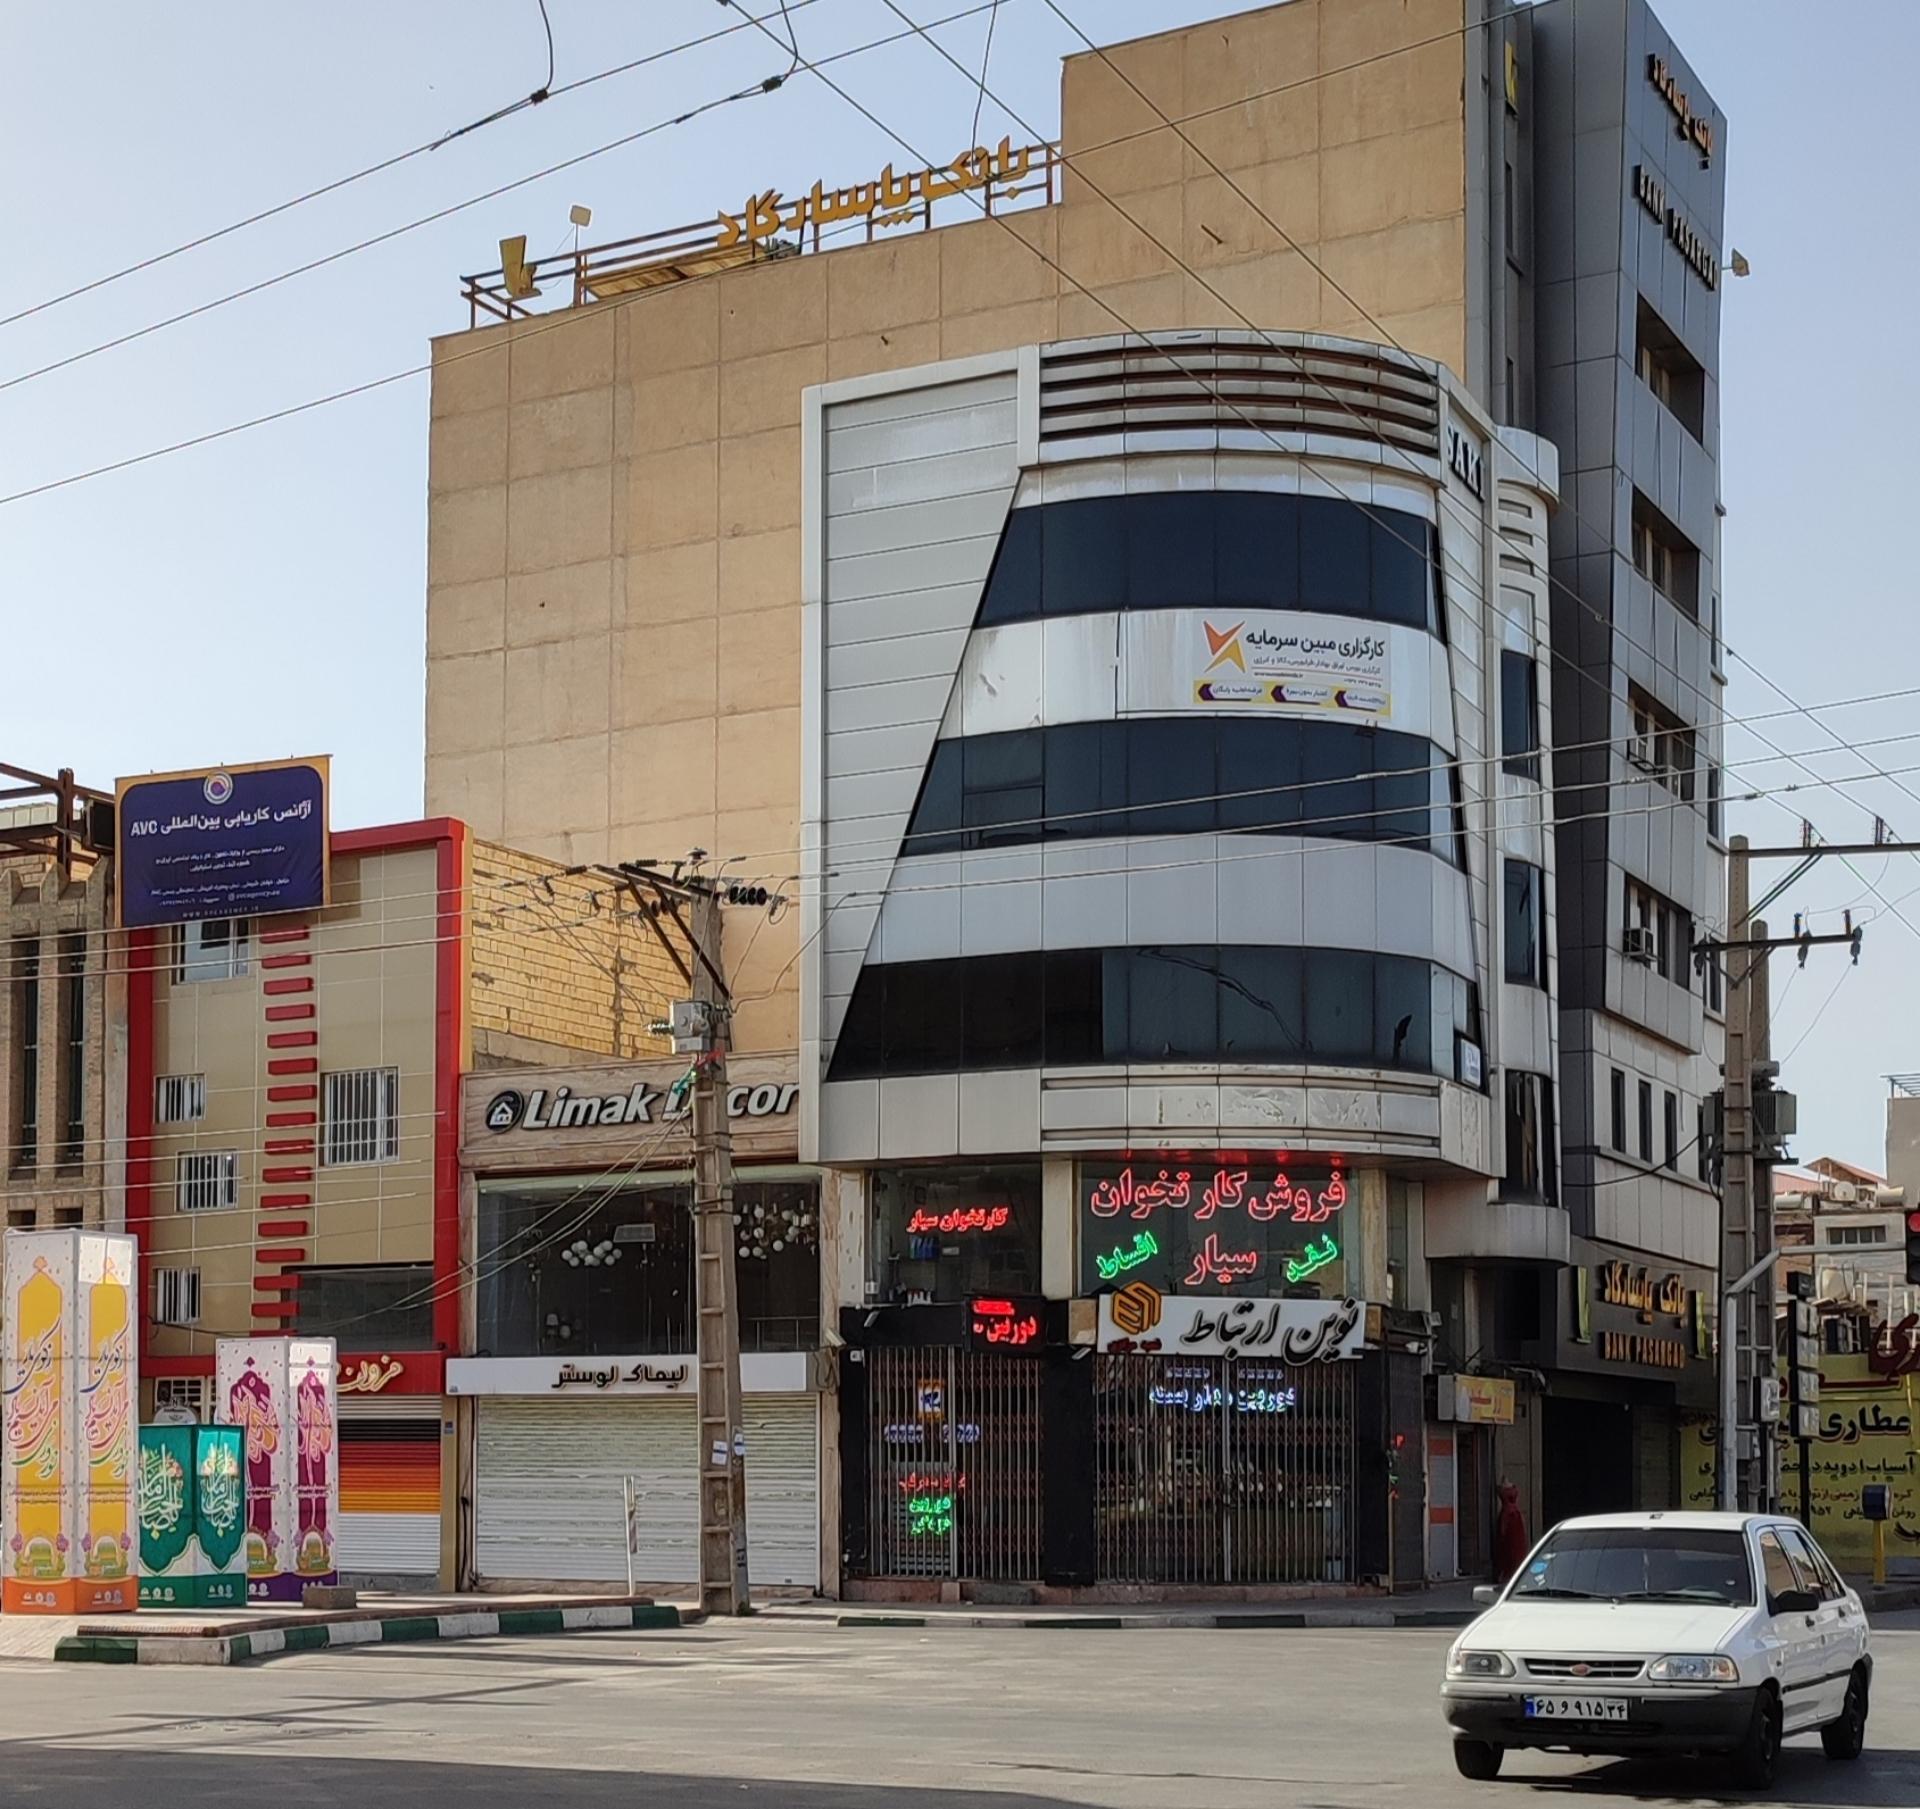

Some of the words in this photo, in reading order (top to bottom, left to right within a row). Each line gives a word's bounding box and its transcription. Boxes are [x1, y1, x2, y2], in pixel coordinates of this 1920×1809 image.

[919, 135, 1030, 200] بانک
[717, 163, 914, 248] پاسارگاد
[1633, 164, 1665, 225] BANK
[1246, 629, 1298, 651] سرمایه
[1300, 638, 1337, 654] مبین
[1338, 636, 1385, 660] کارگزاری
[130, 820, 158, 838] AVC
[224, 806, 270, 828] کاریابی
[274, 800, 312, 822] آژانس
[522, 1082, 658, 1131] Limak
[661, 1081, 800, 1122] Dcor
[1248, 1171, 1347, 1223] فروش
[1096, 1230, 1159, 1280] اقساط
[1184, 1232, 1258, 1286] سیار
[1286, 1233, 1339, 1283] نقد
[1180, 1301, 1280, 1360] ارتباط
[1281, 1295, 1361, 1366] نوین
[1604, 1331, 1632, 1361] BANK
[1636, 1336, 1686, 1370] PASARGAD
[551, 1363, 620, 1389] لوستر
[621, 1362, 689, 1390] لیماک
[1819, 1404, 1912, 1443] عطاری
[1574, 1700, 1604, 1717] ۹۱۵
